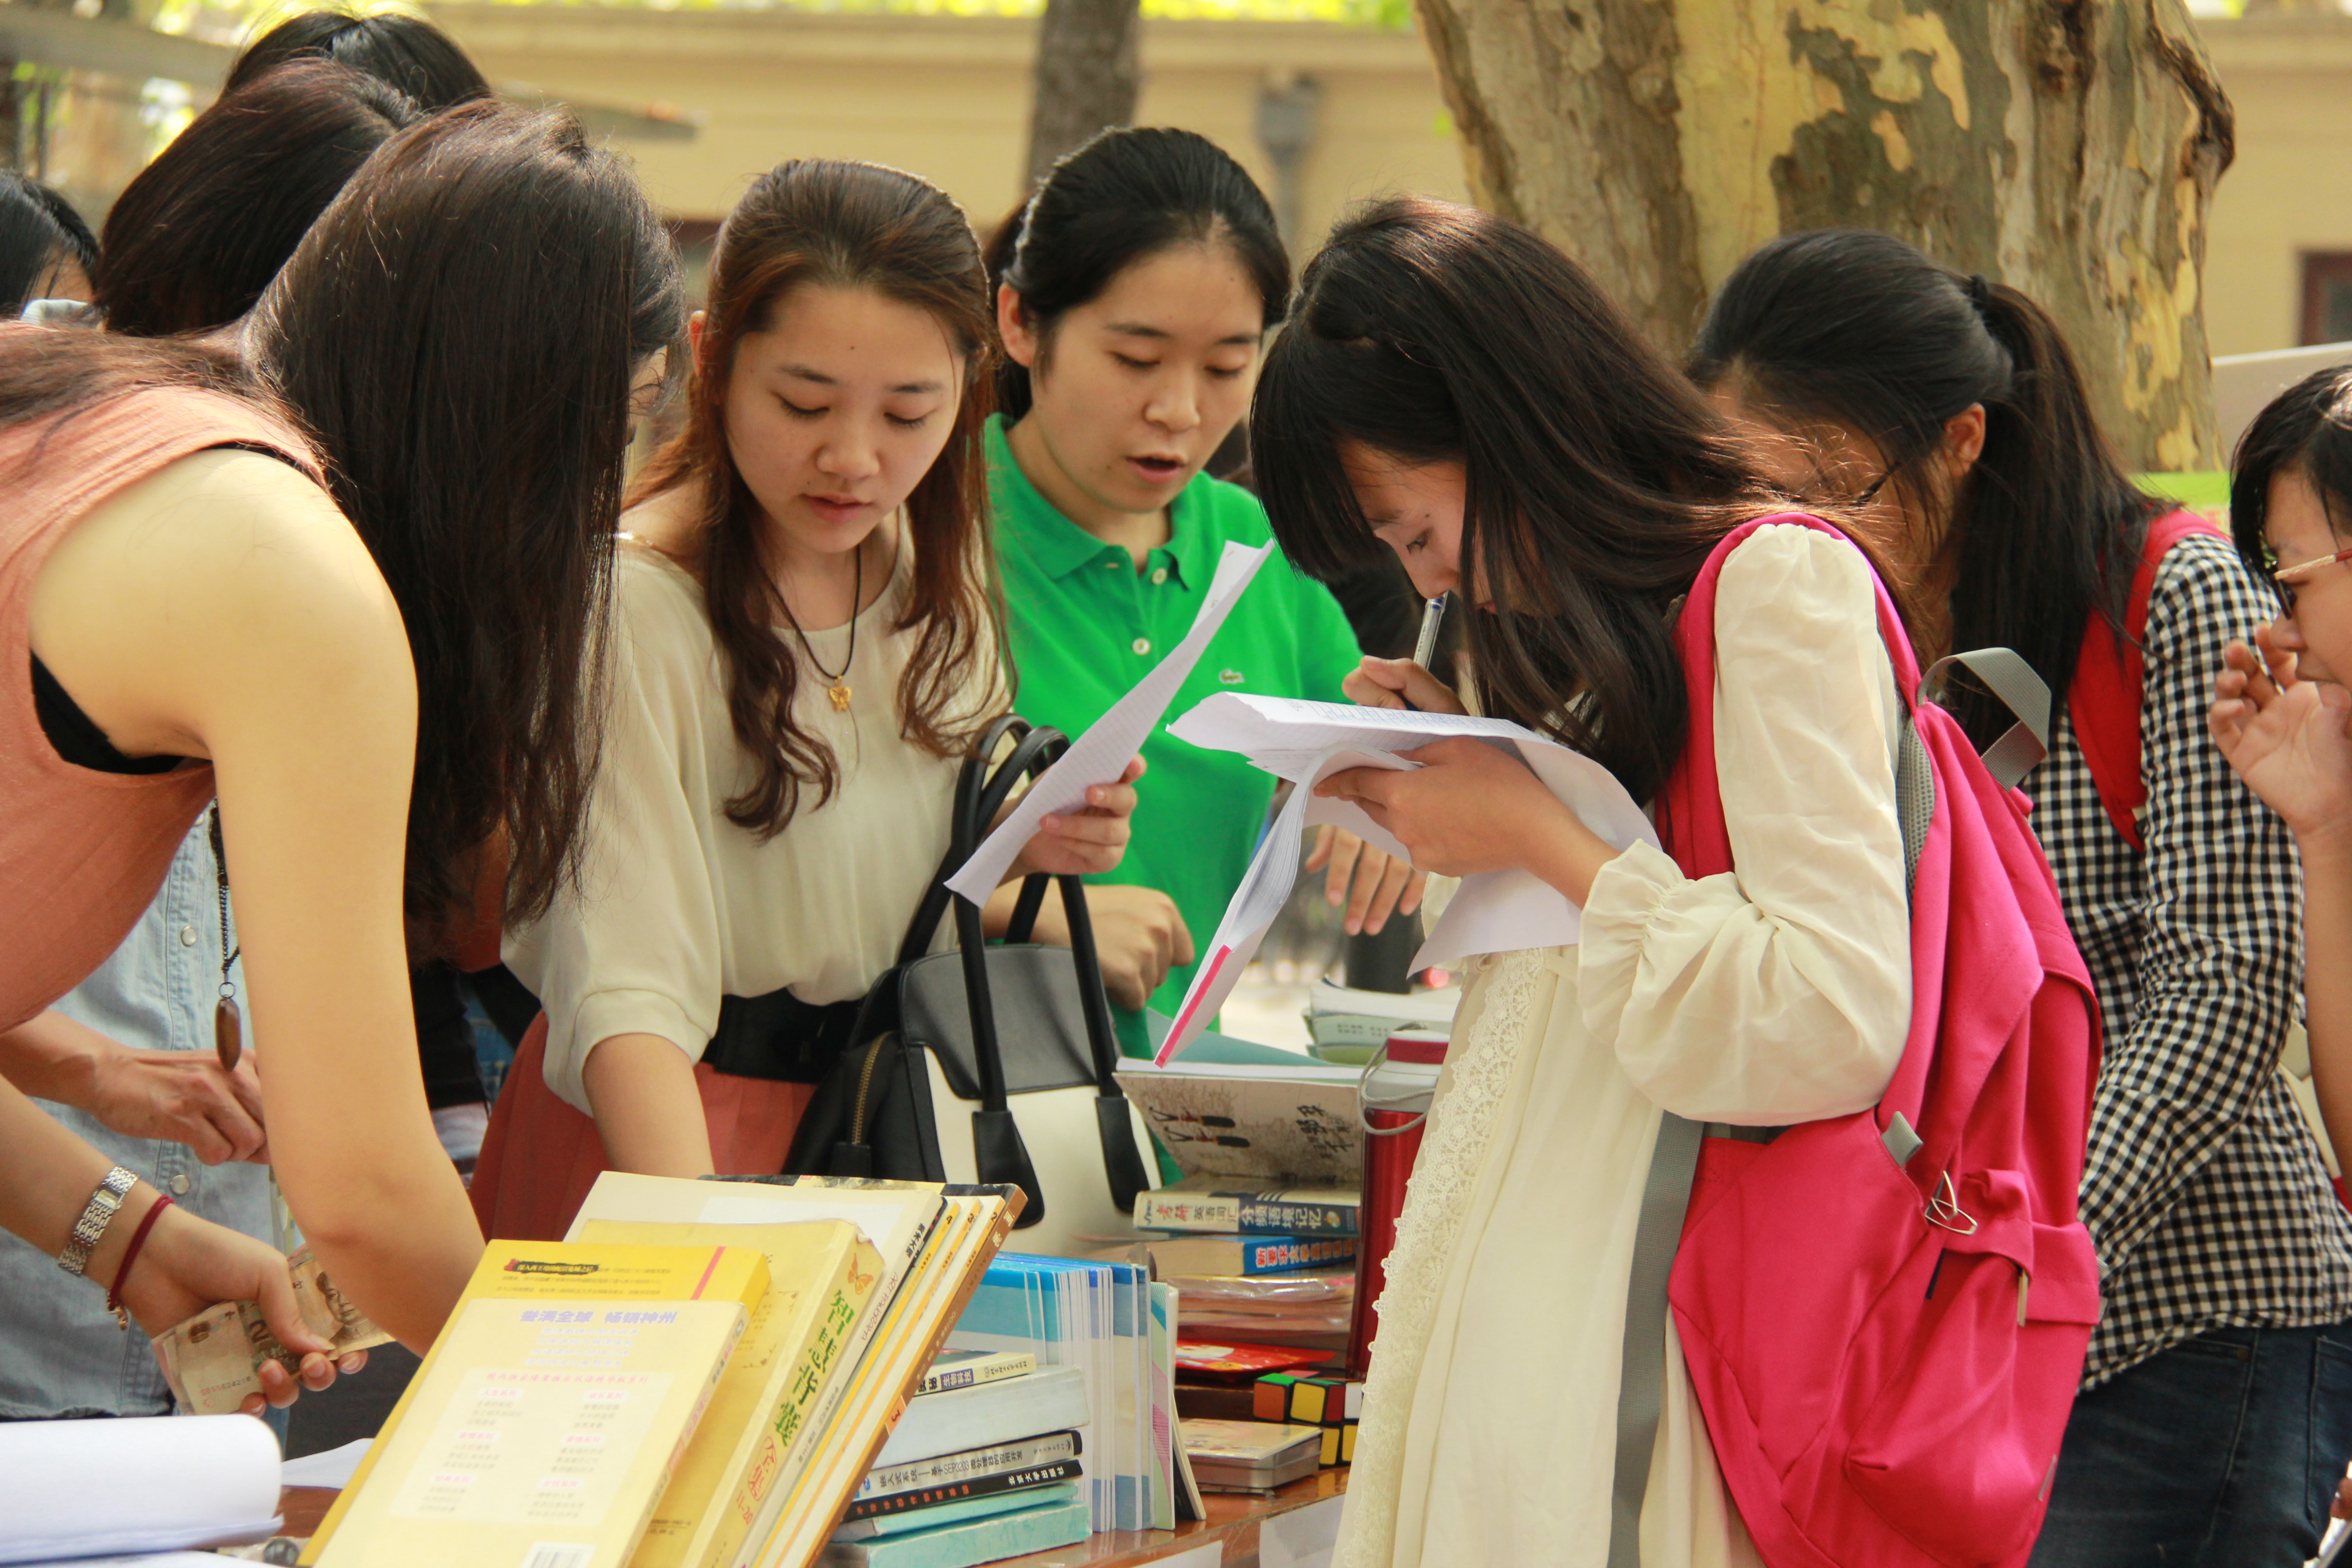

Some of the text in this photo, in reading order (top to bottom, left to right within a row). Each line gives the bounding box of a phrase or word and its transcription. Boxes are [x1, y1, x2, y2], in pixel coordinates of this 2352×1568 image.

[1156, 1204, 1192, 1222] 考研
[1194, 1205, 1237, 1224] 英语词汇
[1240, 1205, 1322, 1229] 分频语境记忆
[520, 1310, 678, 1324] 誉满全球 畅销神州
[775, 1289, 855, 1447] 智慧背囊
[942, 1370, 972, 1387] 生物科技
[749, 1443, 776, 1499] 全集
[1008, 1465, 1064, 1486] 北京大学出版社
[735, 1490, 754, 1525] 11-20
